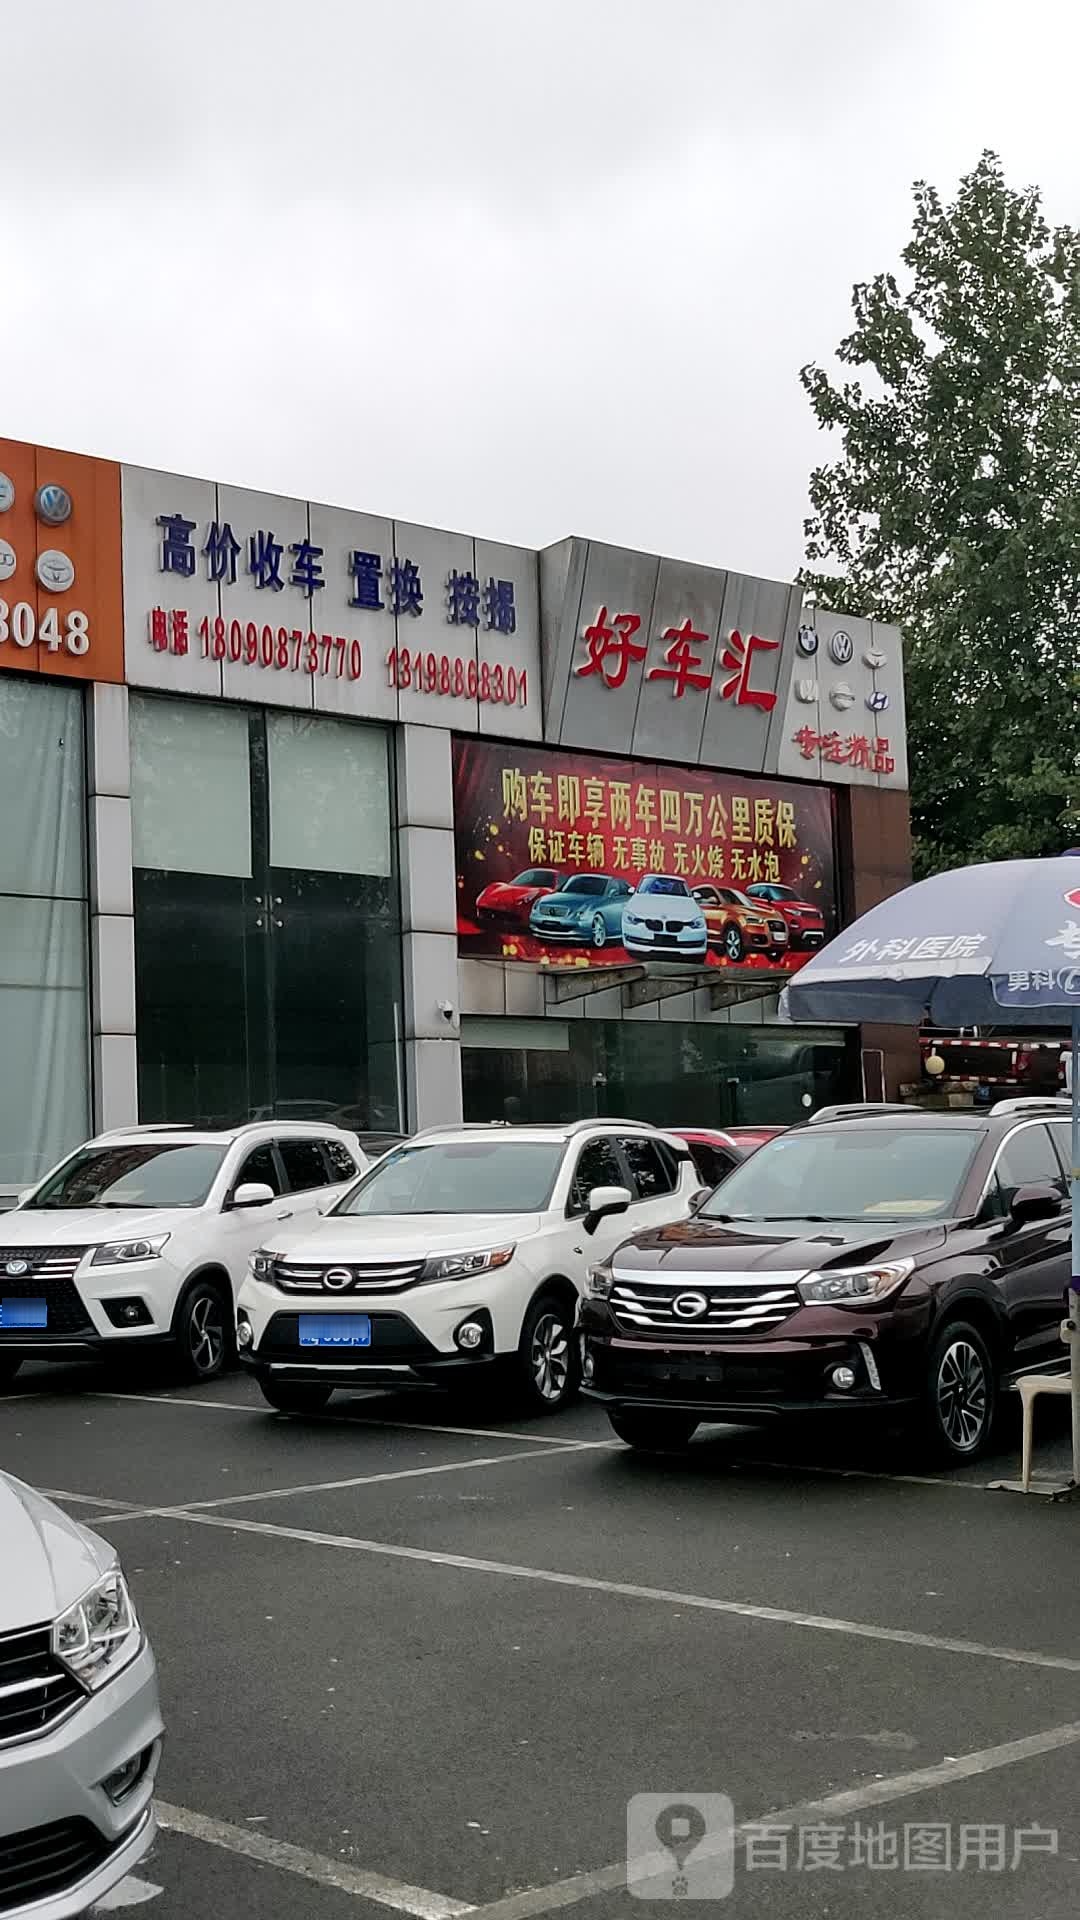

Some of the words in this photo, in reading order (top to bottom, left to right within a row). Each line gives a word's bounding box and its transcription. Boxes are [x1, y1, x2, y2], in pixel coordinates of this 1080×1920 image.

[156, 513, 326, 599] 高价收车
[349, 550, 424, 617] 置换
[149, 605, 189, 656] 电话
[199, 615, 362, 681] 18090873770
[387, 647, 528, 708] 13198868301
[574, 604, 780, 713] 好车汇
[792, 724, 896, 774] 专注精品
[501, 767, 798, 849] 购车即享两年四万公里质保
[527, 826, 606, 868] 保证车辆
[612, 836, 667, 874] 无事故
[673, 842, 725, 880] 无火烧
[730, 848, 781, 883] 无水泡
[839, 933, 988, 963] 外科医院
